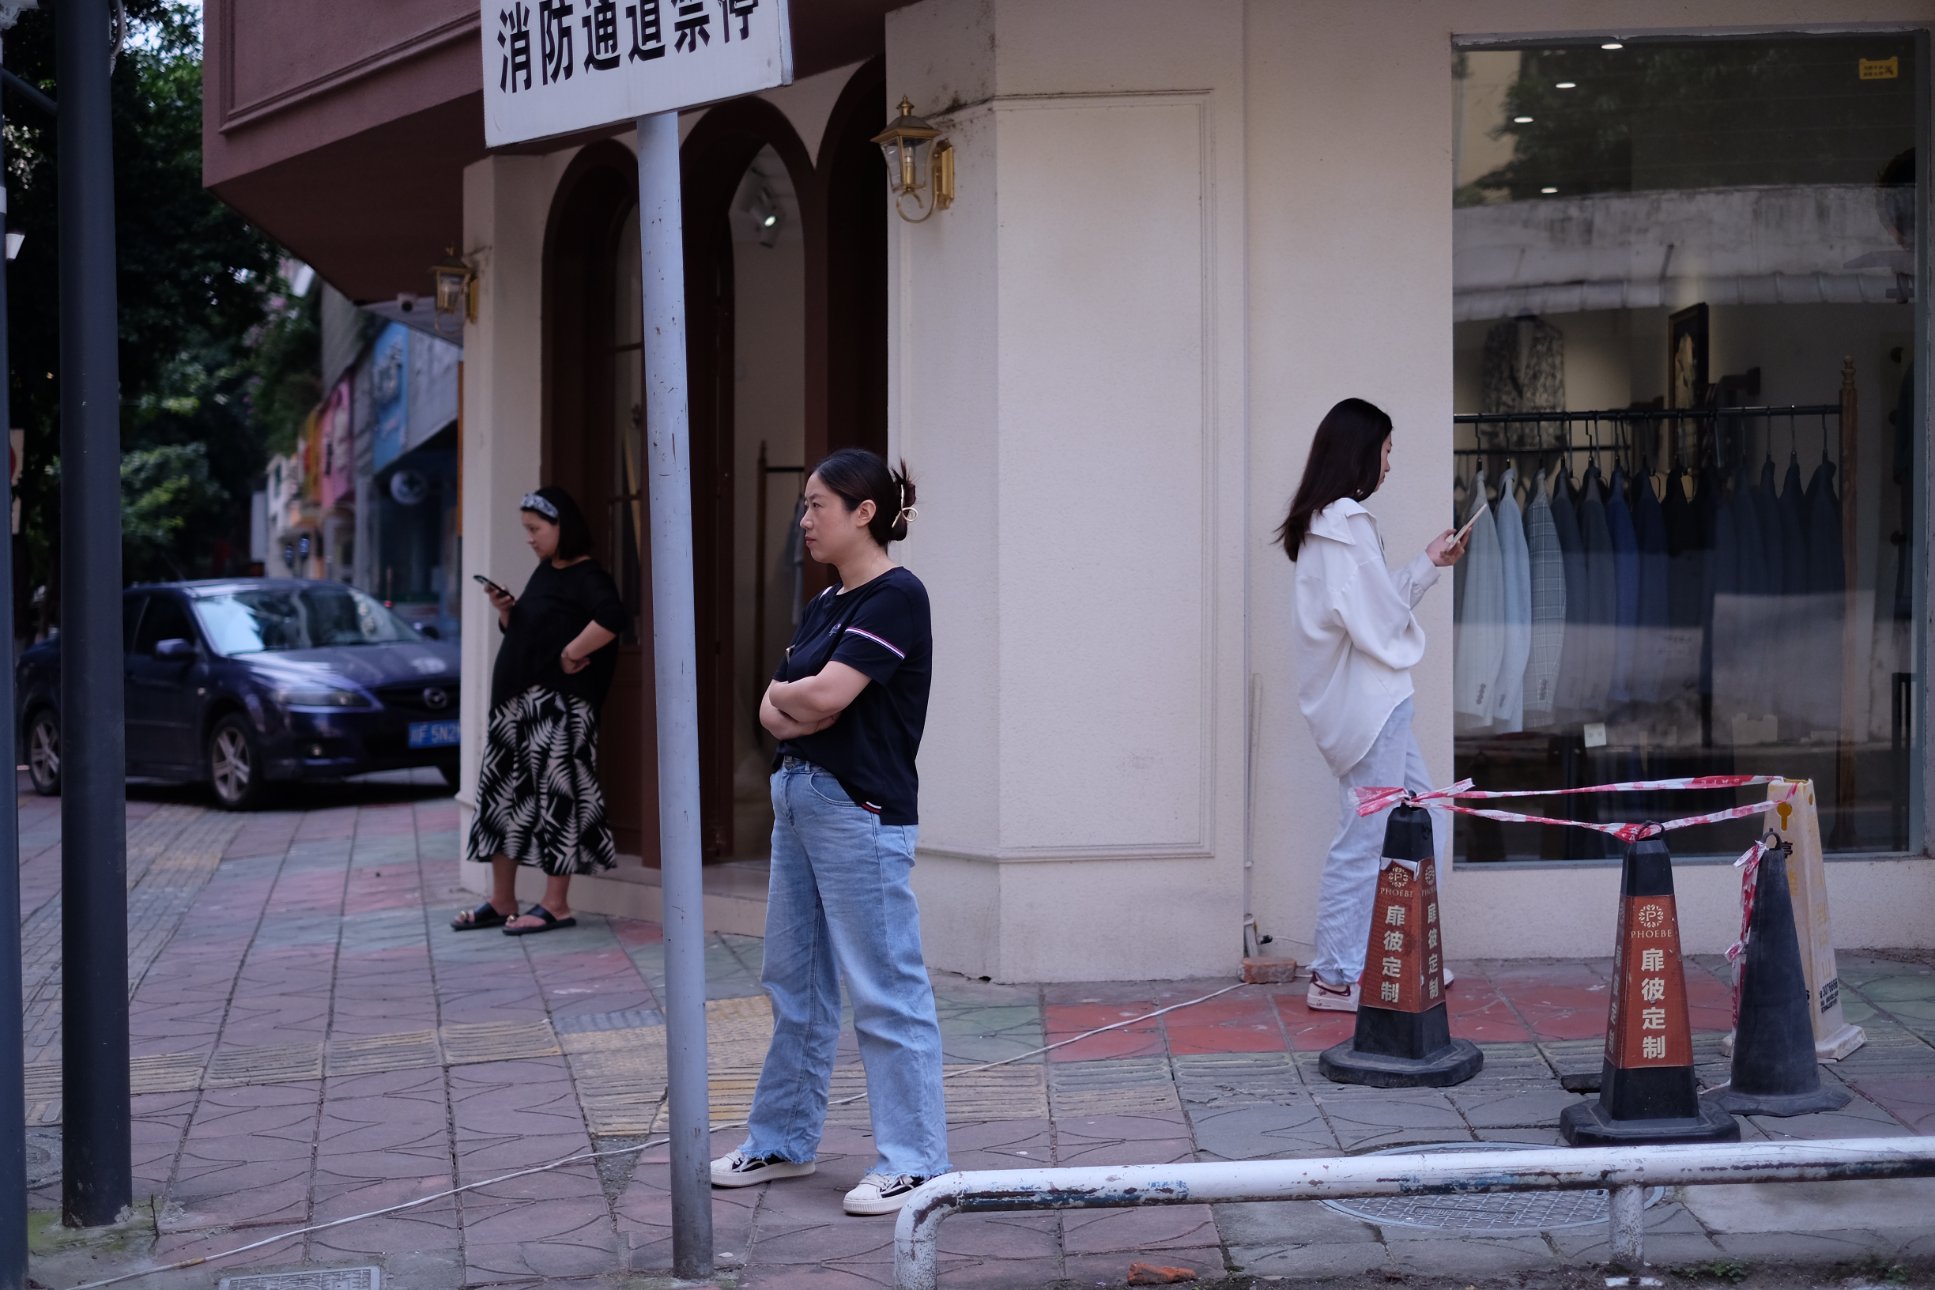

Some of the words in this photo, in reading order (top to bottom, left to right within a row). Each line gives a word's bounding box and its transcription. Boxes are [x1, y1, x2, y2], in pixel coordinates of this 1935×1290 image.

[1630, 929, 1673, 939] PHOEBE
[1641, 948, 1666, 1059] 扉彼定制
